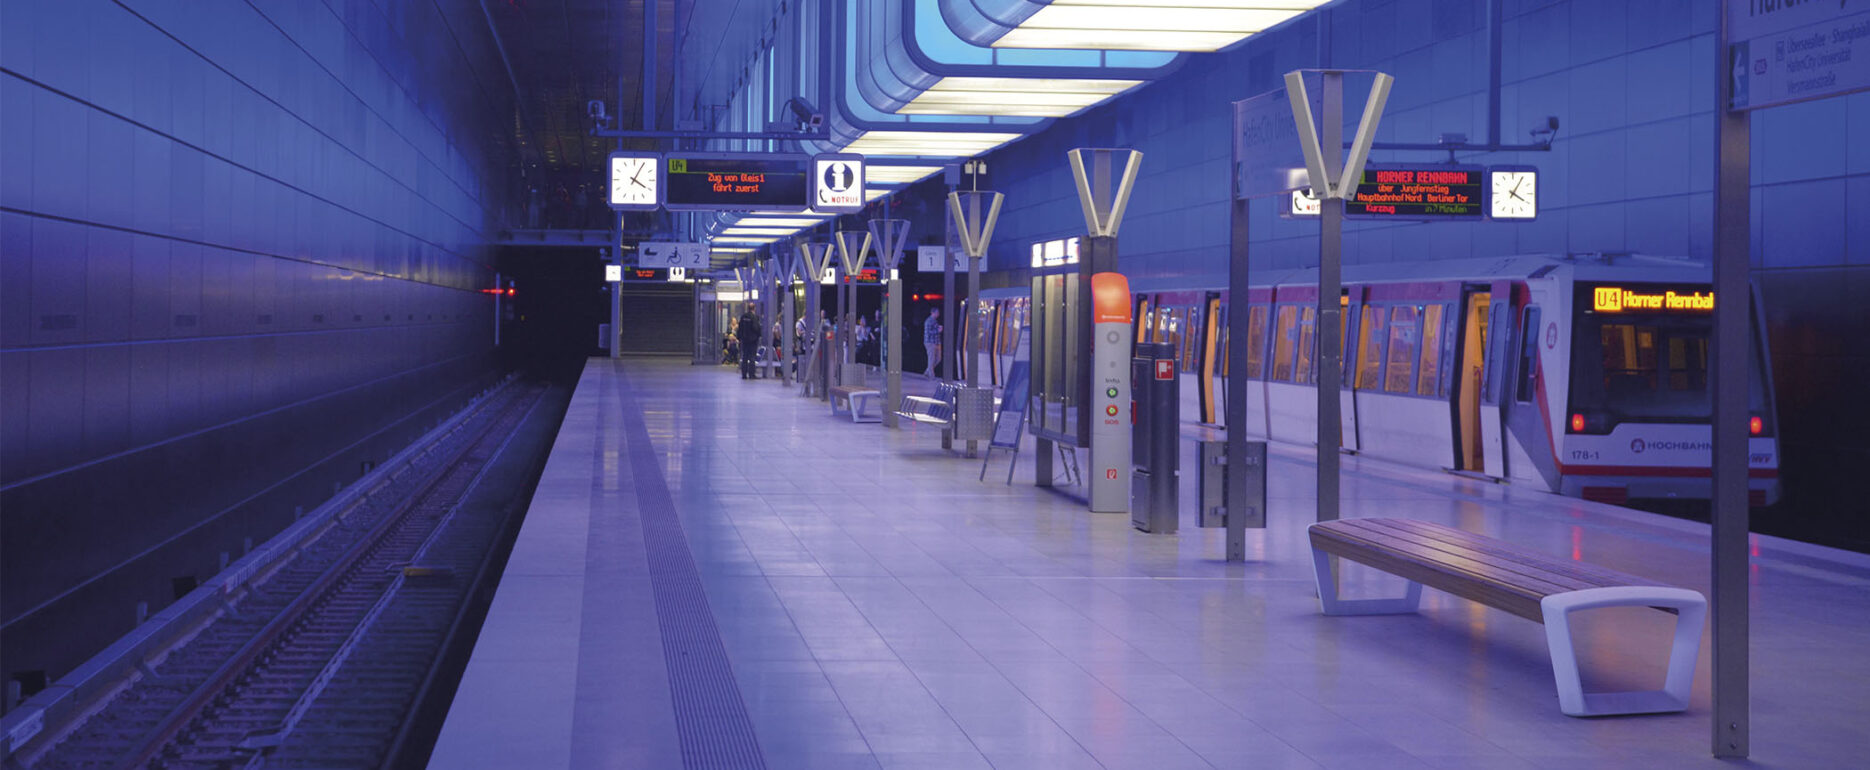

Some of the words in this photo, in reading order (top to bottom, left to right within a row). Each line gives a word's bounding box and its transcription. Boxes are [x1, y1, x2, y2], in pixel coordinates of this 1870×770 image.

[708, 173, 723, 183] Zug
[725, 174, 738, 182] von
[1376, 171, 1413, 183] HORNER
[1417, 171, 1468, 184] RENNBAHN
[735, 183, 759, 192] zuerst
[1378, 184, 1394, 192] über
[1400, 184, 1449, 194] Jungfernstieg
[1427, 194, 1456, 202] Berliner
[1456, 194, 1469, 203] Tor
[1366, 204, 1395, 214] Kurzzug
[693, 253, 700, 264] 2
[1597, 291, 1618, 307] U4
[1623, 290, 1664, 308] Horner
[1572, 450, 1600, 460] 178-1
